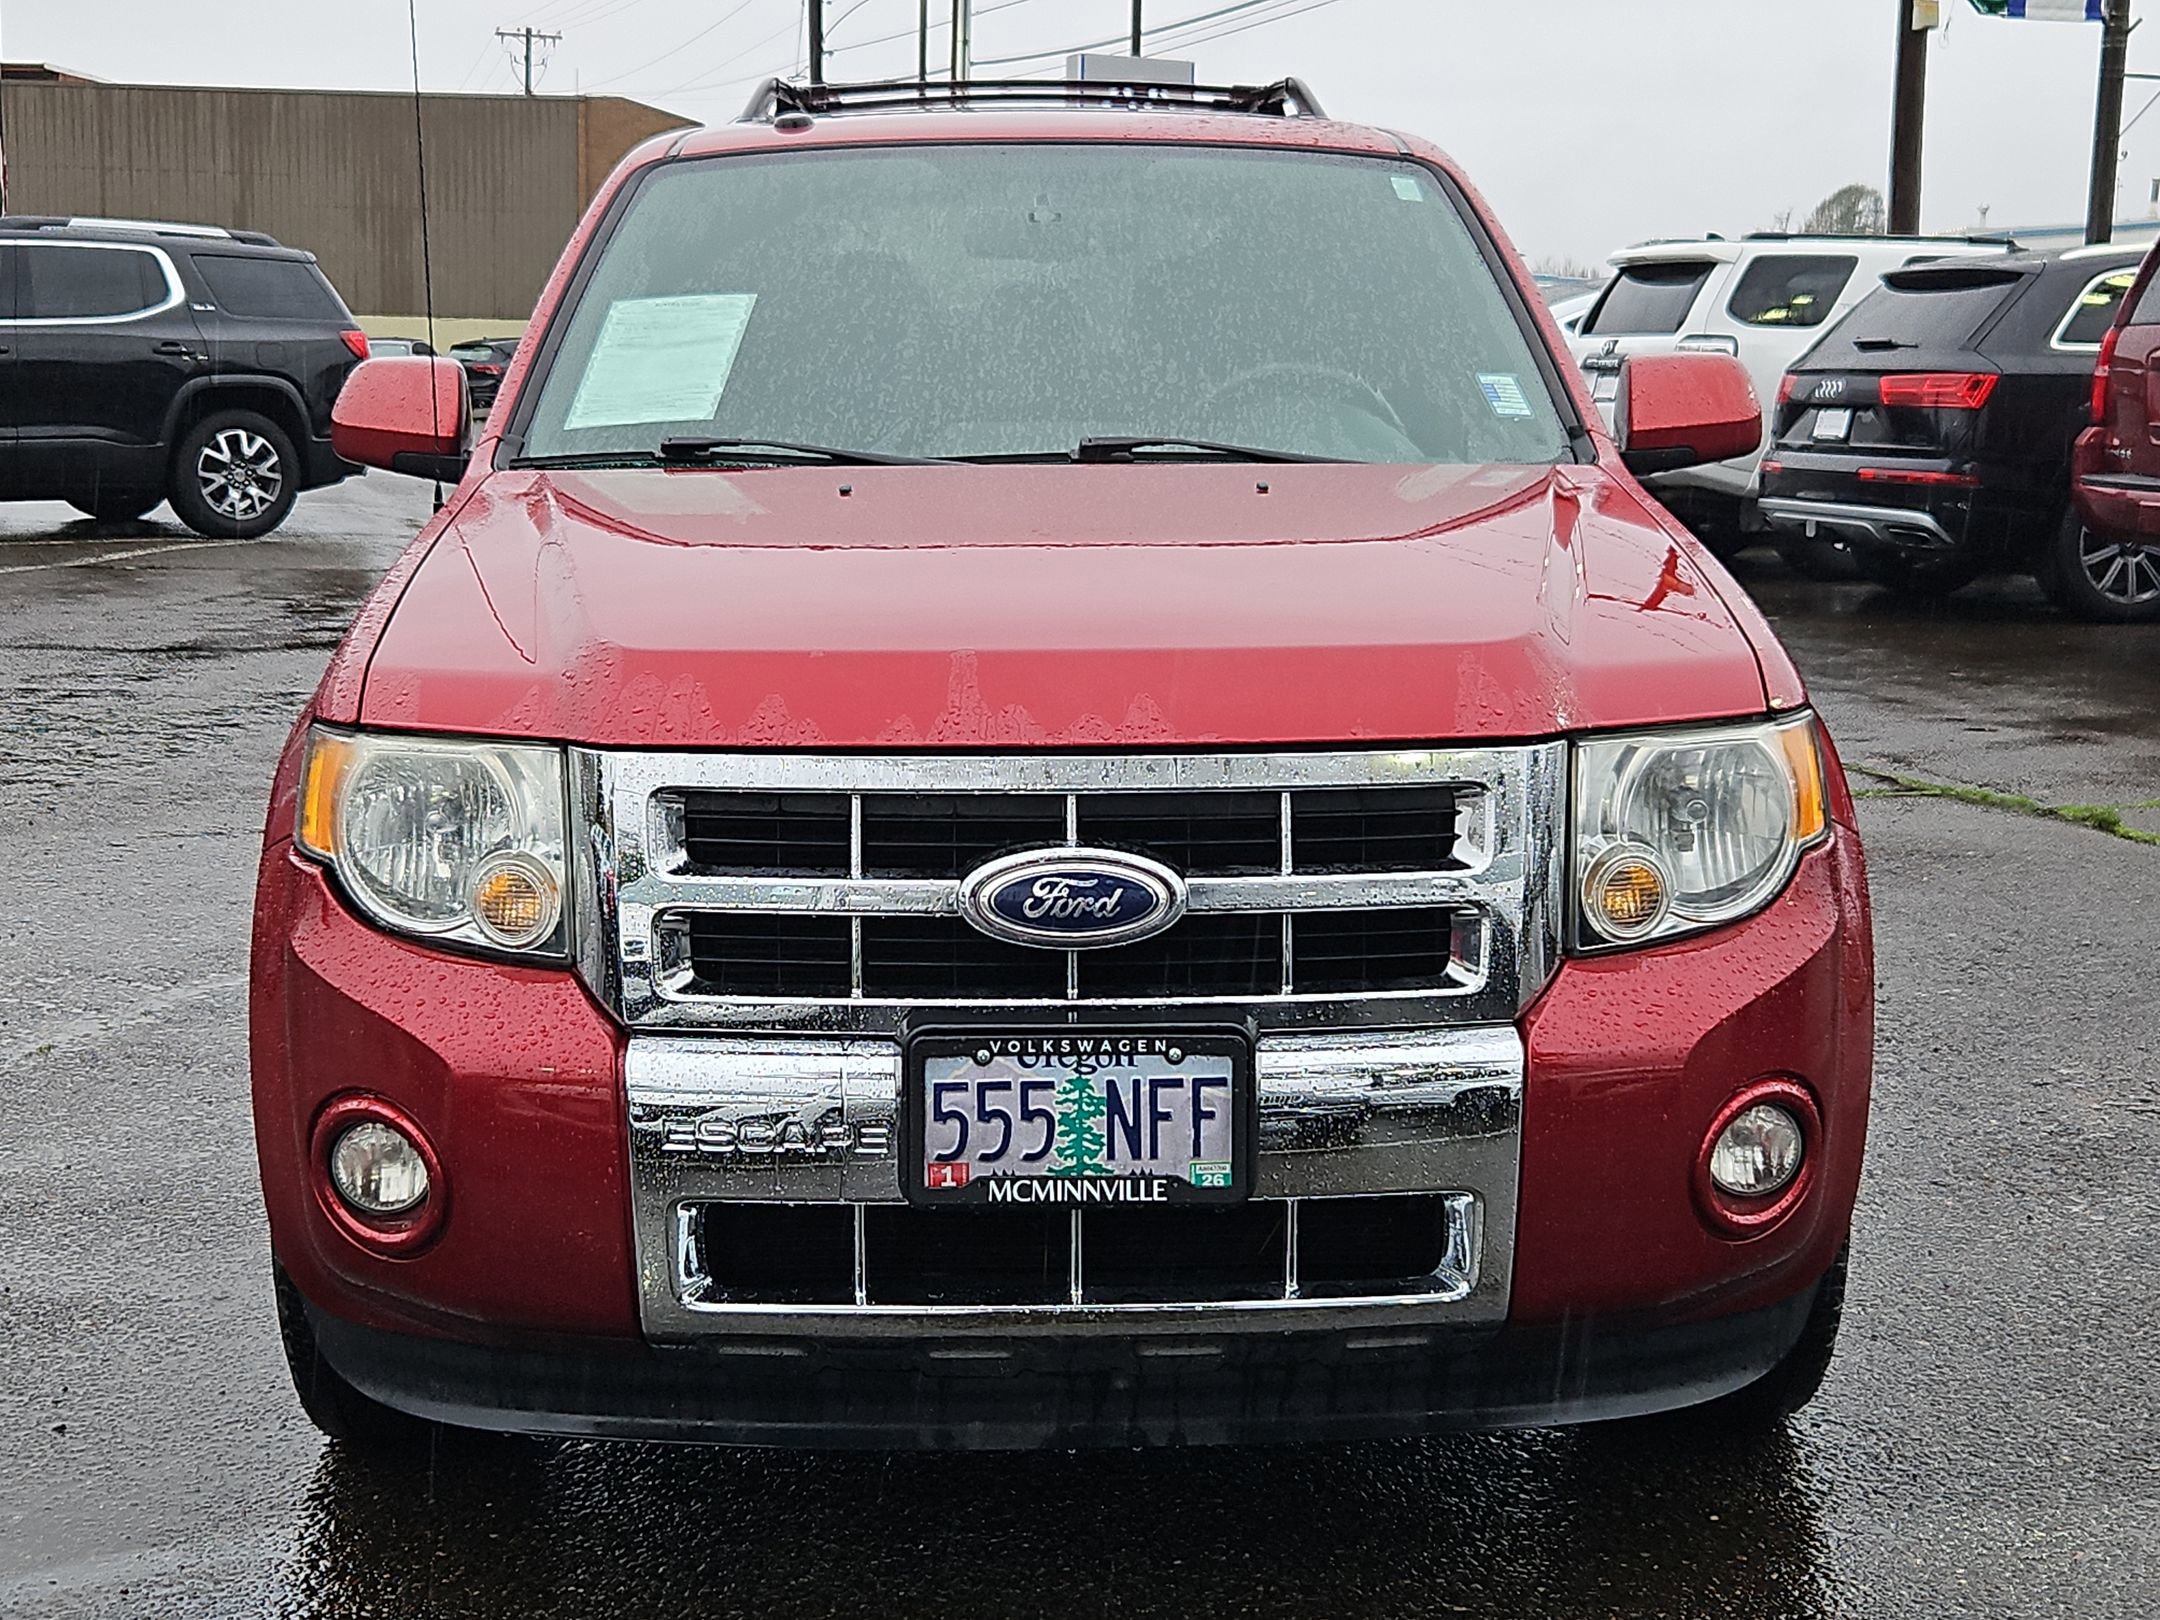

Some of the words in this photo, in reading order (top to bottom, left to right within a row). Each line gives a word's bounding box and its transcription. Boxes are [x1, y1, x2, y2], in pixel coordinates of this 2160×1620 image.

[1023, 876, 1124, 918] Ford
[989, 1039, 1168, 1053] VOLKSWAGEN
[932, 1080, 1056, 1162] 555
[1105, 1077, 1228, 1161] NFF
[661, 1116, 890, 1154] ESCAPE
[988, 1179, 1168, 1202] MCMINNVILLE
[1201, 1173, 1225, 1187] 26
